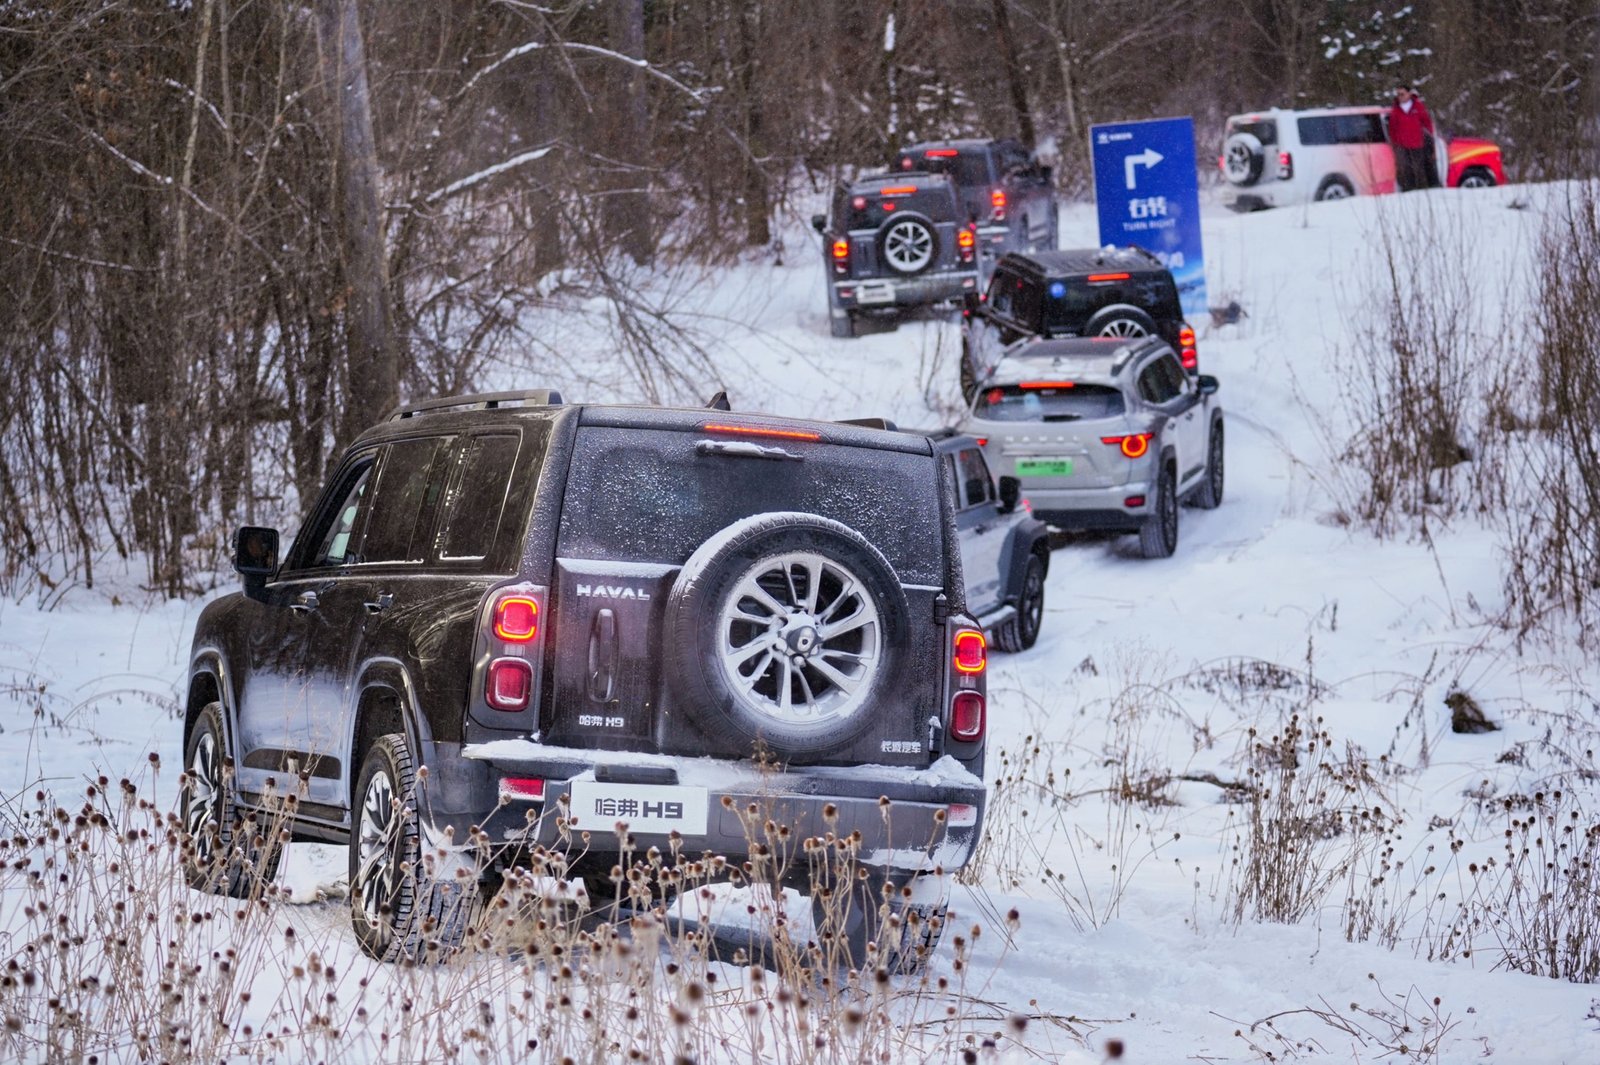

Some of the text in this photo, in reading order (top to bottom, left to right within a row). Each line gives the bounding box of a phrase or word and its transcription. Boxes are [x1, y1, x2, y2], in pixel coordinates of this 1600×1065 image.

[1122, 221, 1148, 231] TURN
[576, 583, 651, 601] HAVAL
[579, 714, 625, 728] 哈弗 H9
[595, 798, 684, 819] 哈弗 H9
